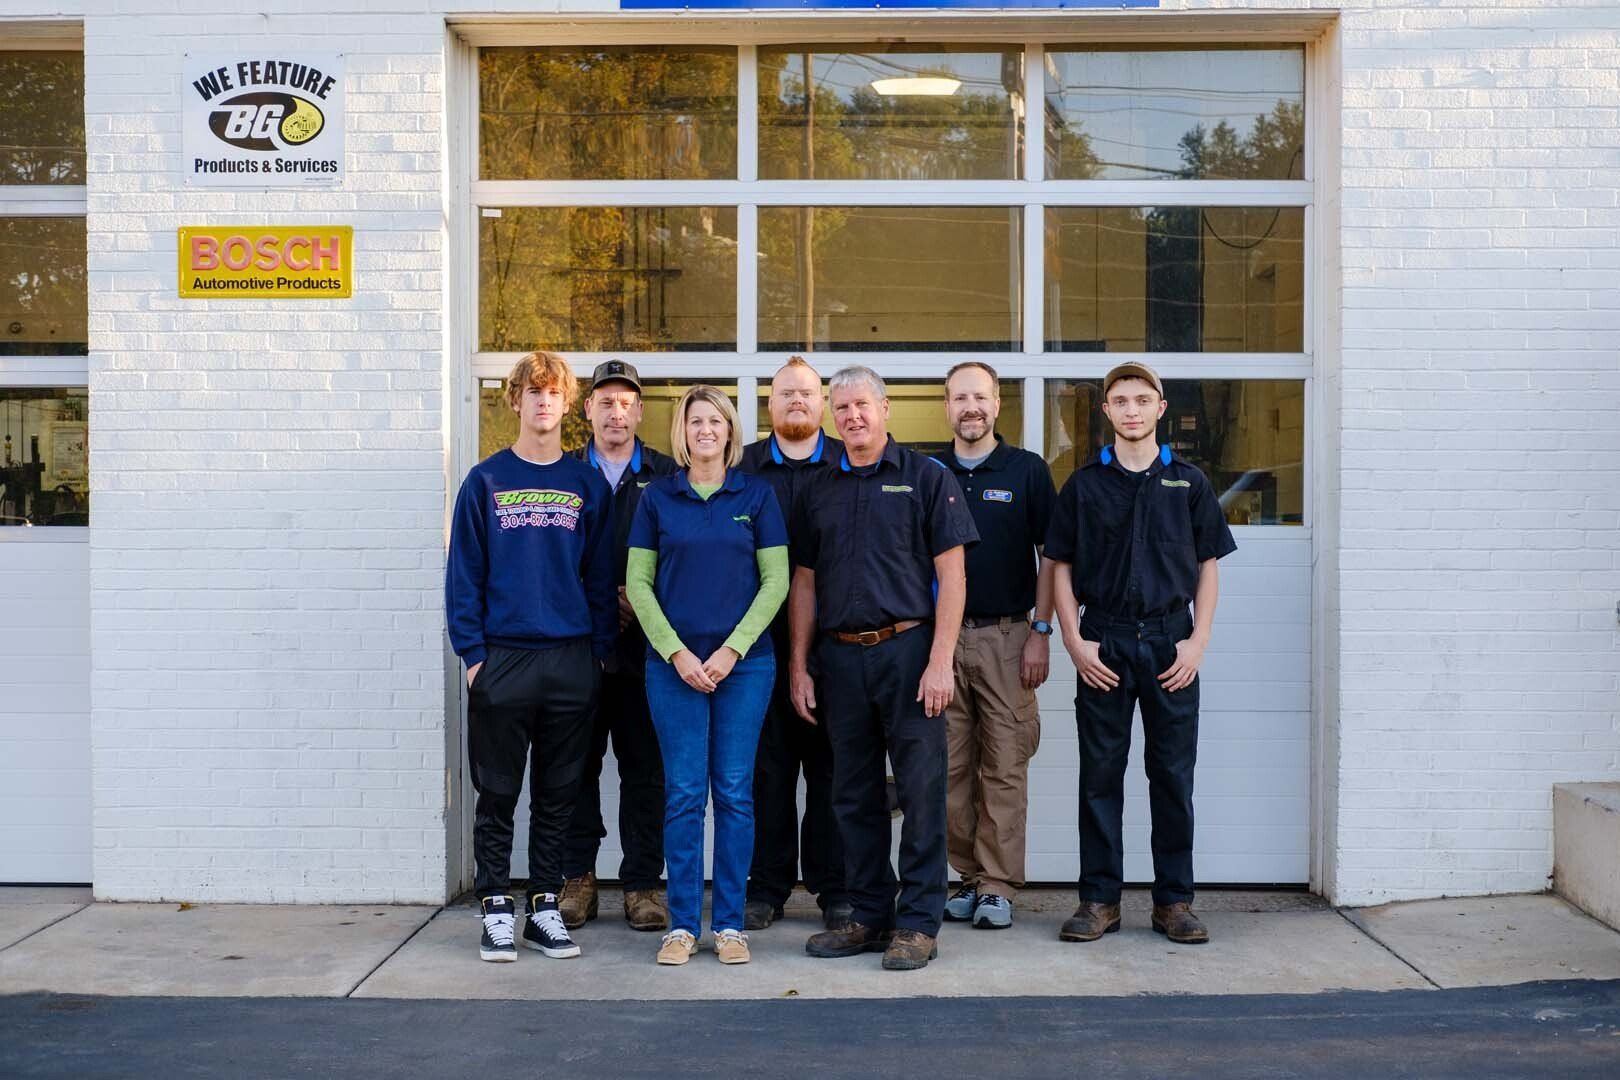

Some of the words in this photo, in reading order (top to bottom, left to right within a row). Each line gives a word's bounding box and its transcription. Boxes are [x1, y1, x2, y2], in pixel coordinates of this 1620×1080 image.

[192, 66, 234, 102] WE
[237, 60, 337, 101] FEATURE
[222, 103, 285, 140] BG
[194, 157, 259, 173] Products
[262, 159, 272, 173] &
[275, 157, 338, 173] Services
[191, 234, 341, 272] BOSCH
[192, 276, 274, 290] Automotive
[277, 276, 341, 290] Products
[496, 490, 583, 508] Brown's
